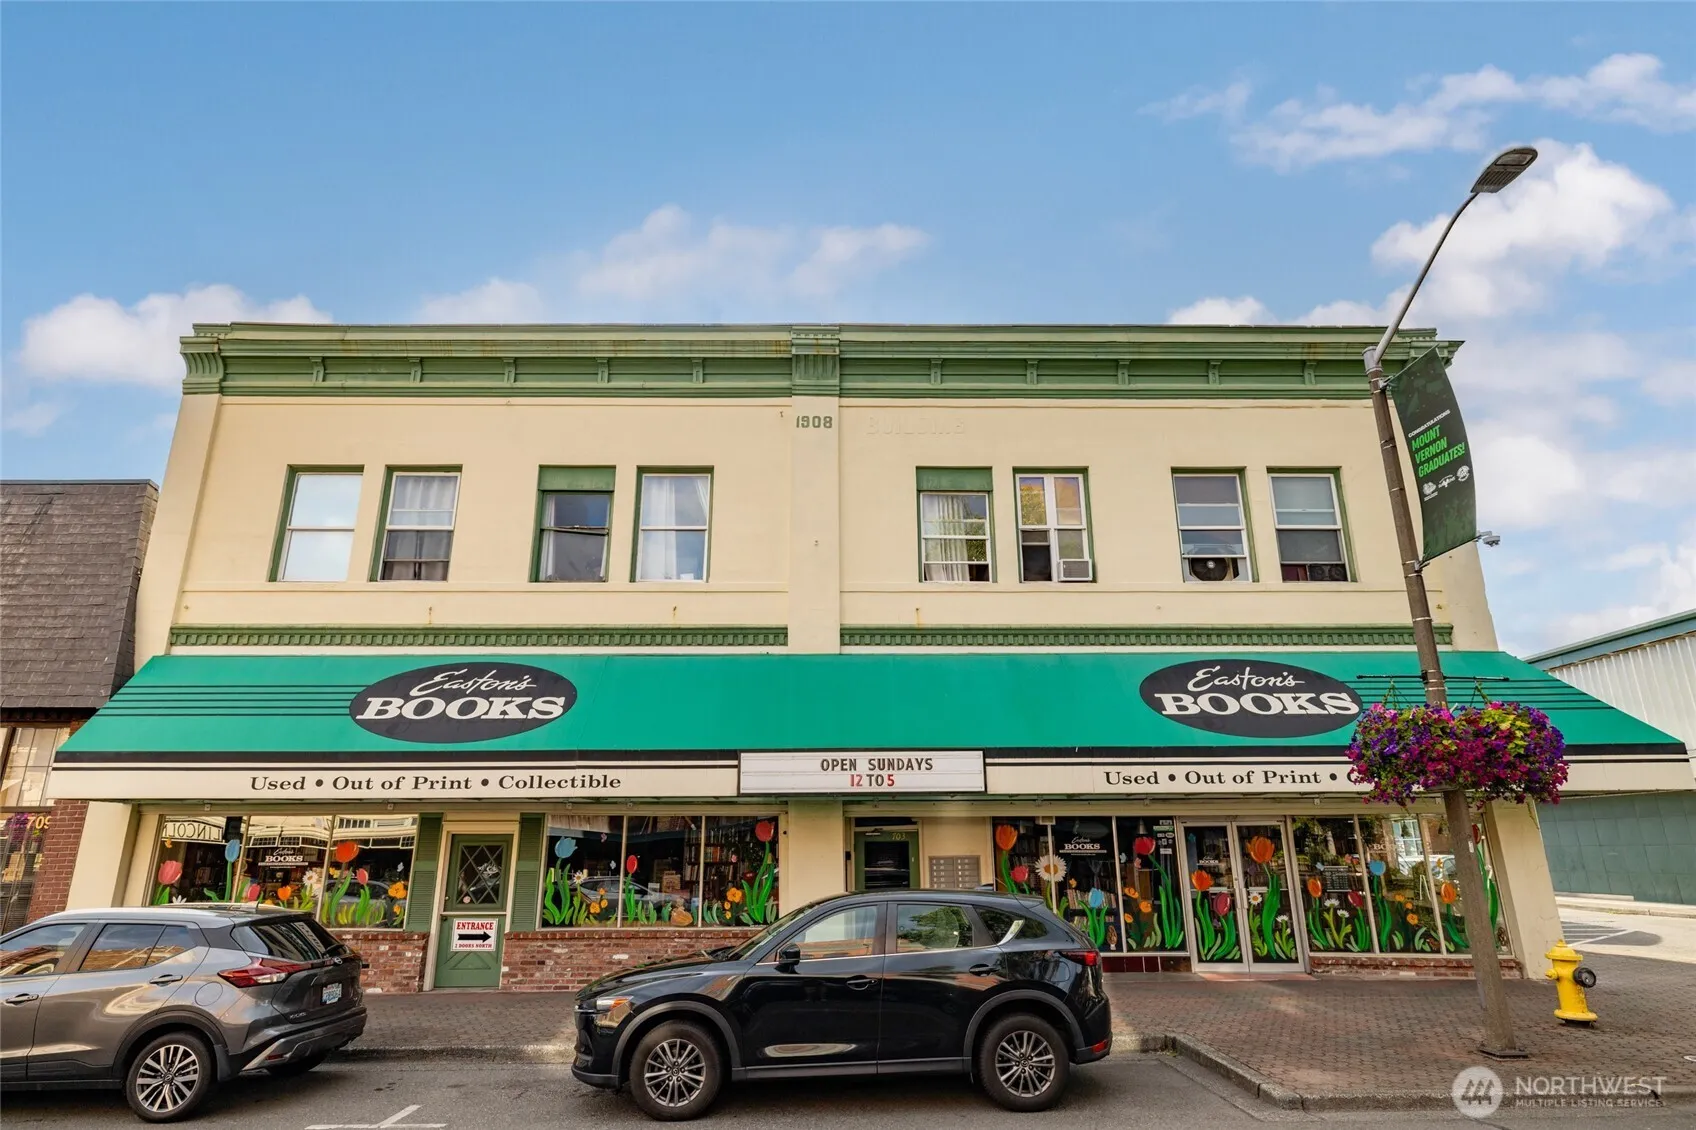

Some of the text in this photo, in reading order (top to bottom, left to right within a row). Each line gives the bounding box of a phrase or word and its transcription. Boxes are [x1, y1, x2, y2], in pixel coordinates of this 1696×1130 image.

[796, 415, 833, 428] 1908
[1411, 424, 1440, 451] MOUNT
[1415, 436, 1447, 464] VERNON
[1418, 442, 1465, 478] GRADUATES!
[409, 668, 537, 697] Easton's
[1187, 665, 1305, 692] Easton's
[356, 696, 566, 720] BOOKS
[1154, 692, 1360, 716] BOOKS
[820, 757, 933, 771] OPEN SUNDAYS
[250, 774, 622, 791] Used Out of Print Collectible
[850, 774, 895, 787] 12 TO 5
[1103, 770, 1322, 785] Used Out of Print
[891, 833, 906, 841] 703
[456, 921, 494, 930] ENTRANCE
